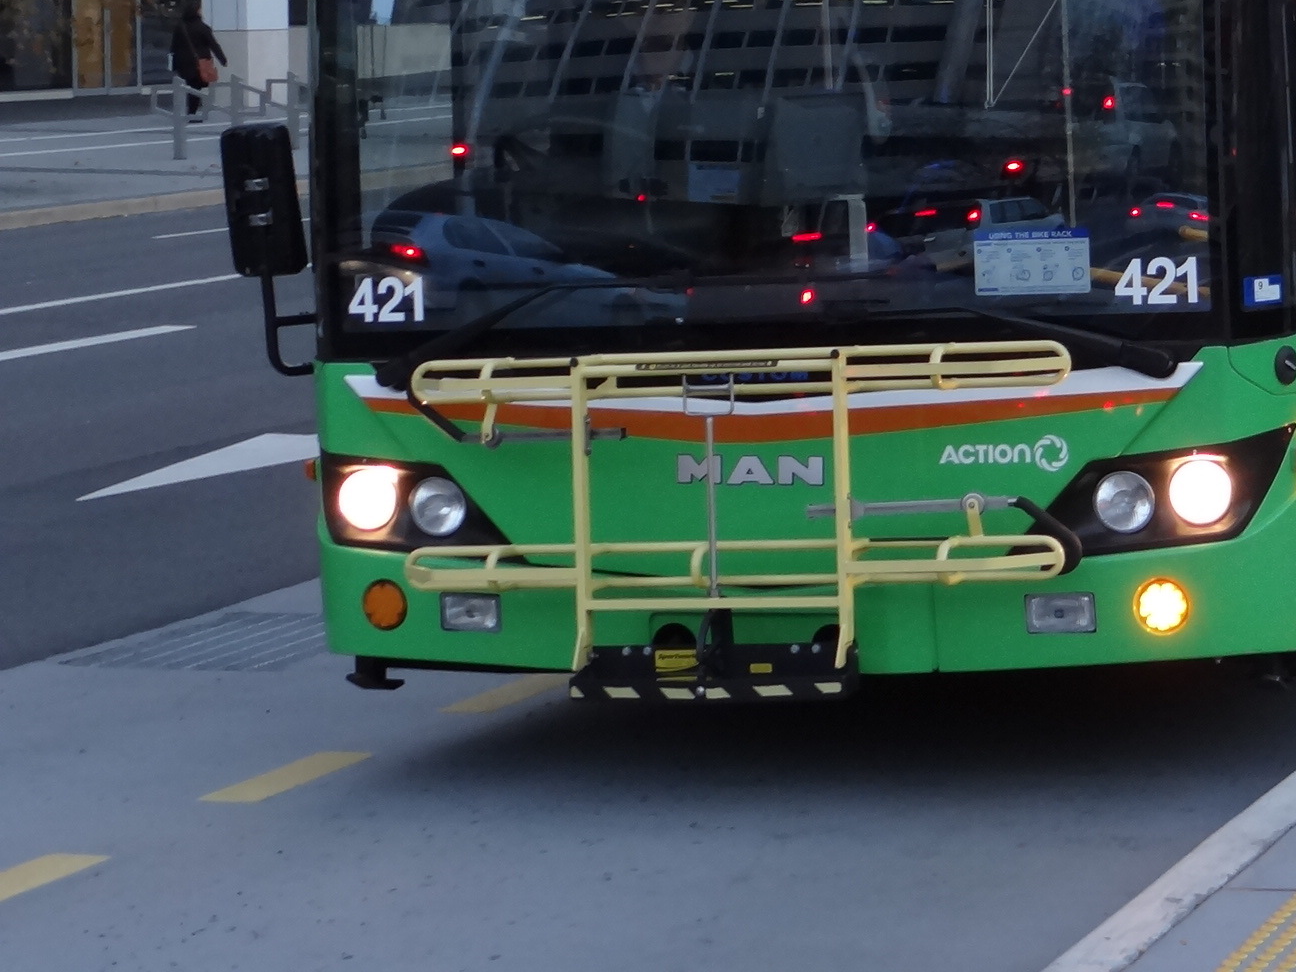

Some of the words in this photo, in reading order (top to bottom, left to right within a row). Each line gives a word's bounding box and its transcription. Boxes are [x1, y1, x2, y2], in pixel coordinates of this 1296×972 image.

[988, 232, 1013, 240] USING
[1015, 231, 1030, 239] THE
[1031, 231, 1050, 239] BIKE
[1051, 230, 1073, 238] RACK
[1113, 255, 1200, 307] 421
[348, 276, 425, 324] 421
[676, 452, 825, 487] MAN
[939, 441, 1031, 465] ACTION
